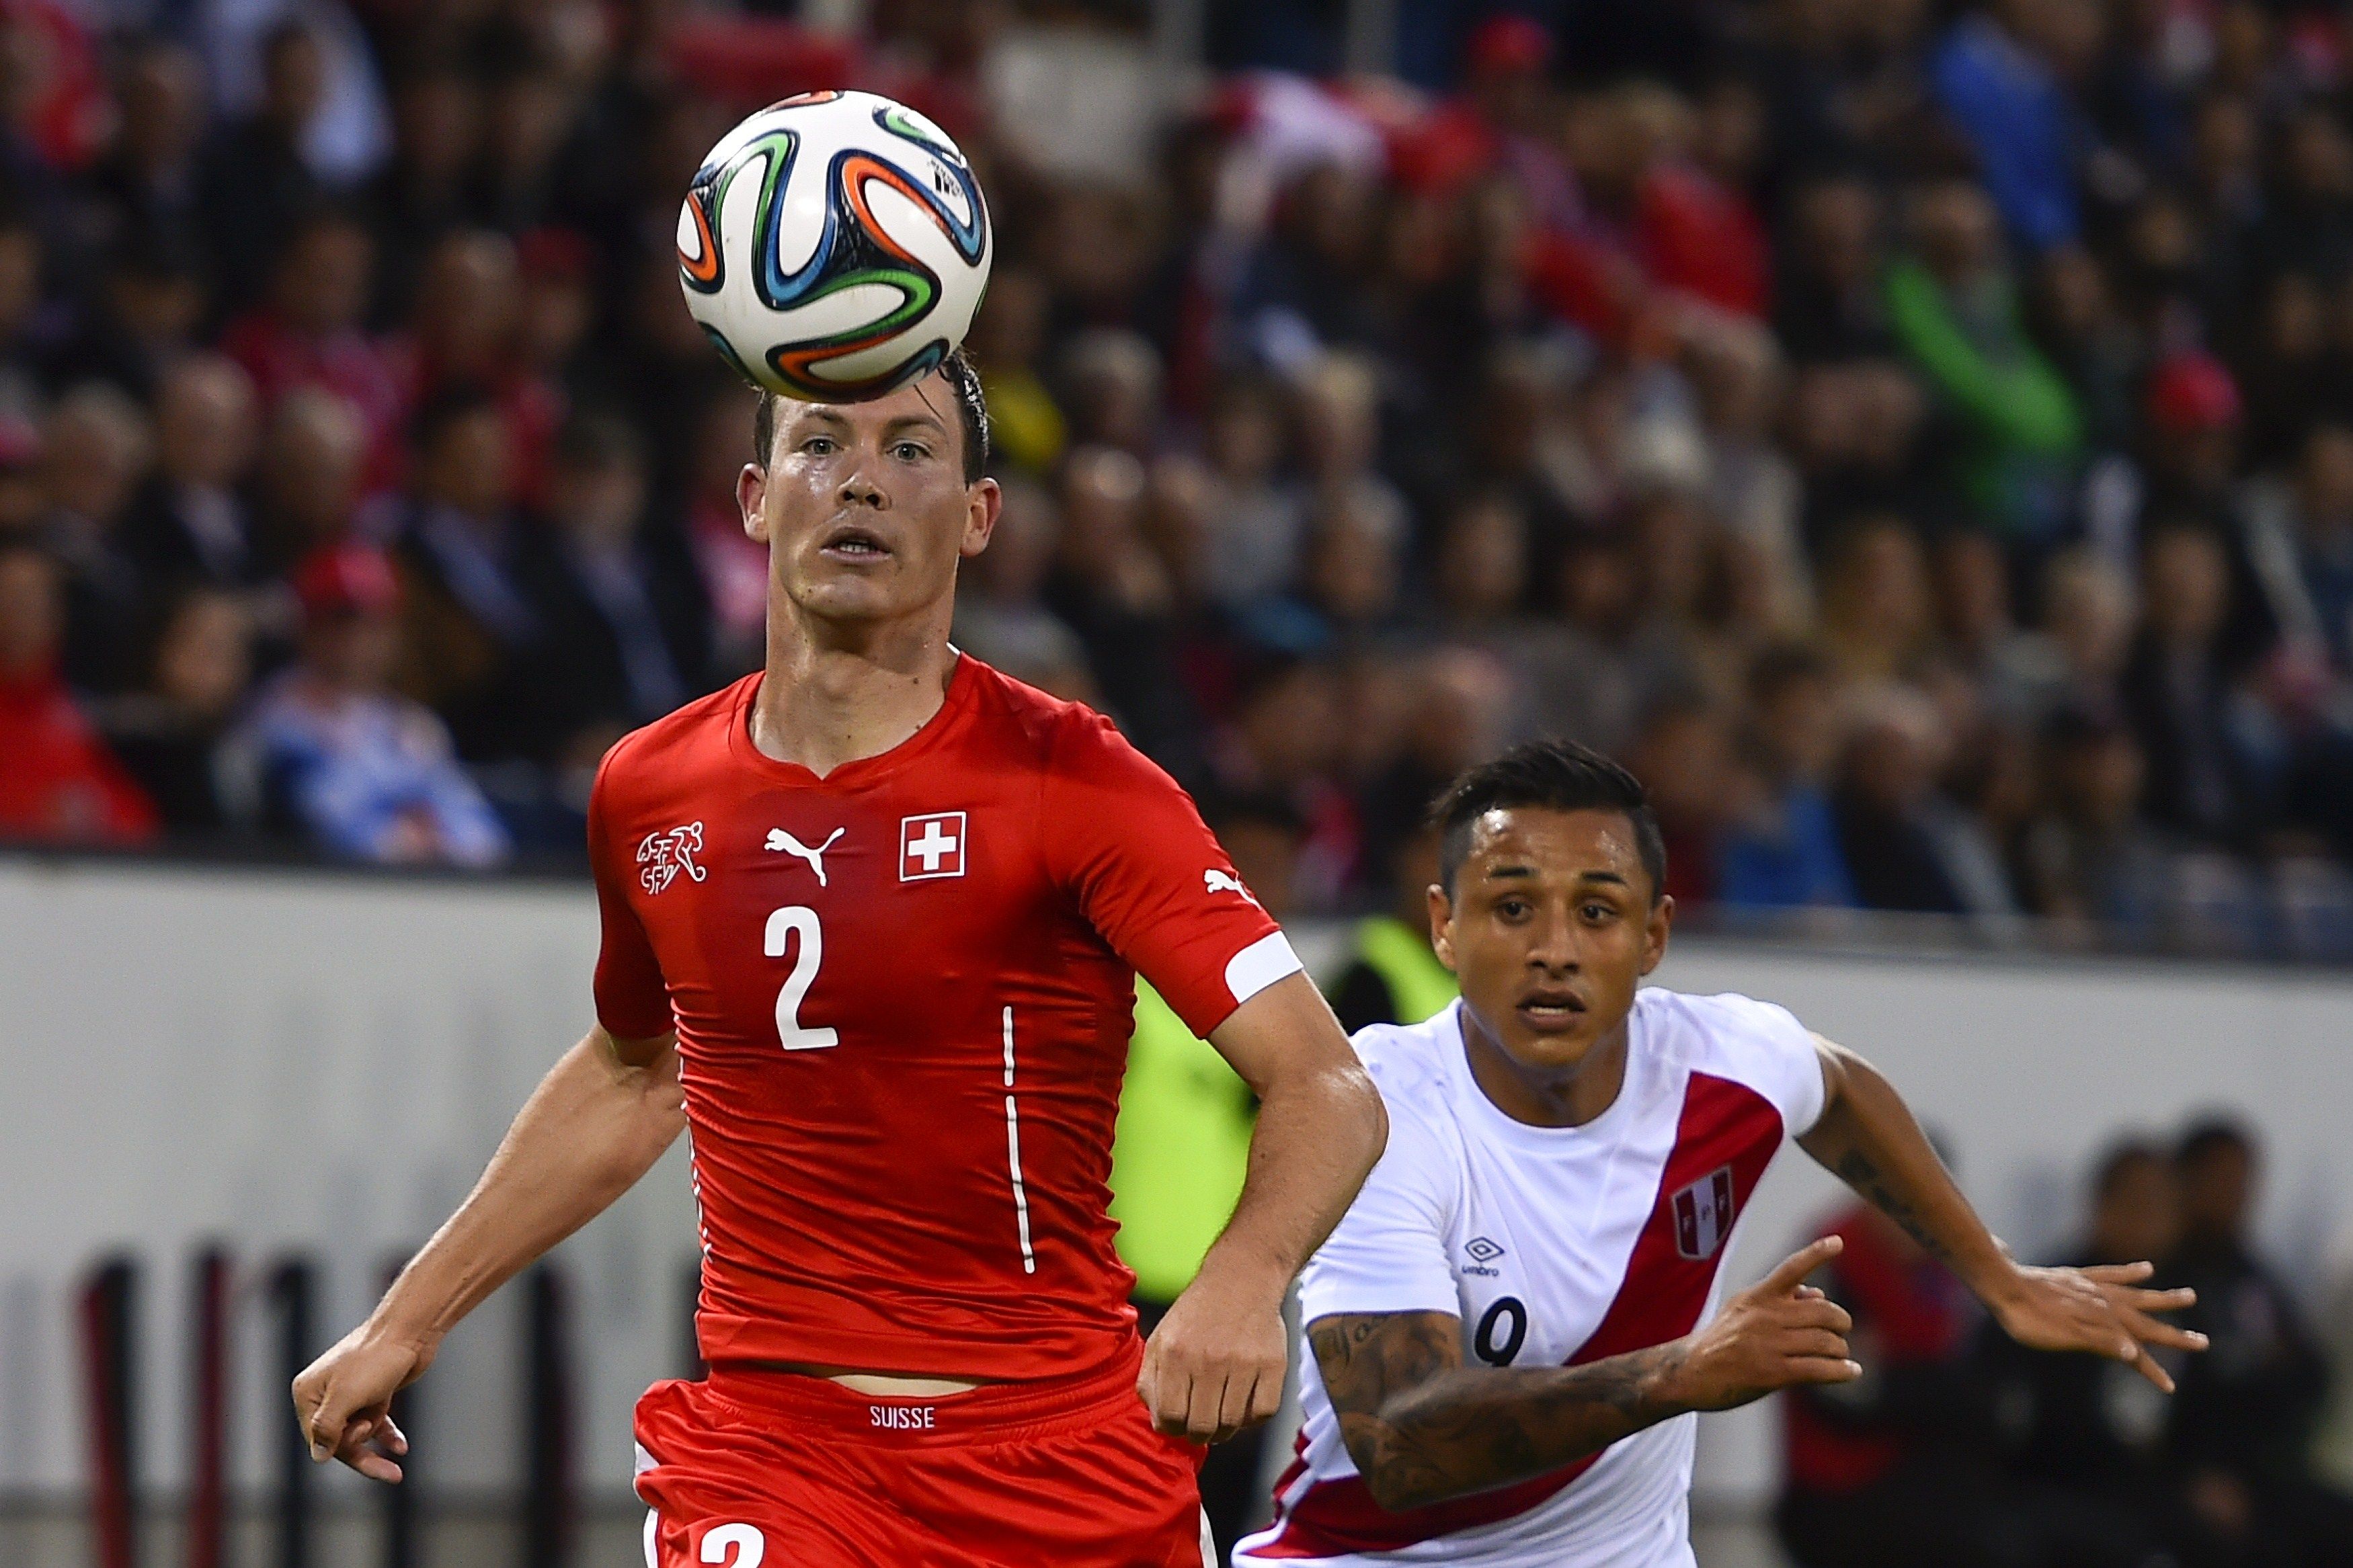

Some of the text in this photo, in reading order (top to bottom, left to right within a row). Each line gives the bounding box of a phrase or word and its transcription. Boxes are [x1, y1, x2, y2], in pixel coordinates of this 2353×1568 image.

[764, 906, 838, 1050] 2
[1462, 1265, 1499, 1276] umbro
[1474, 1296, 1527, 1367] 9
[870, 1406, 934, 1428] SUISSE
